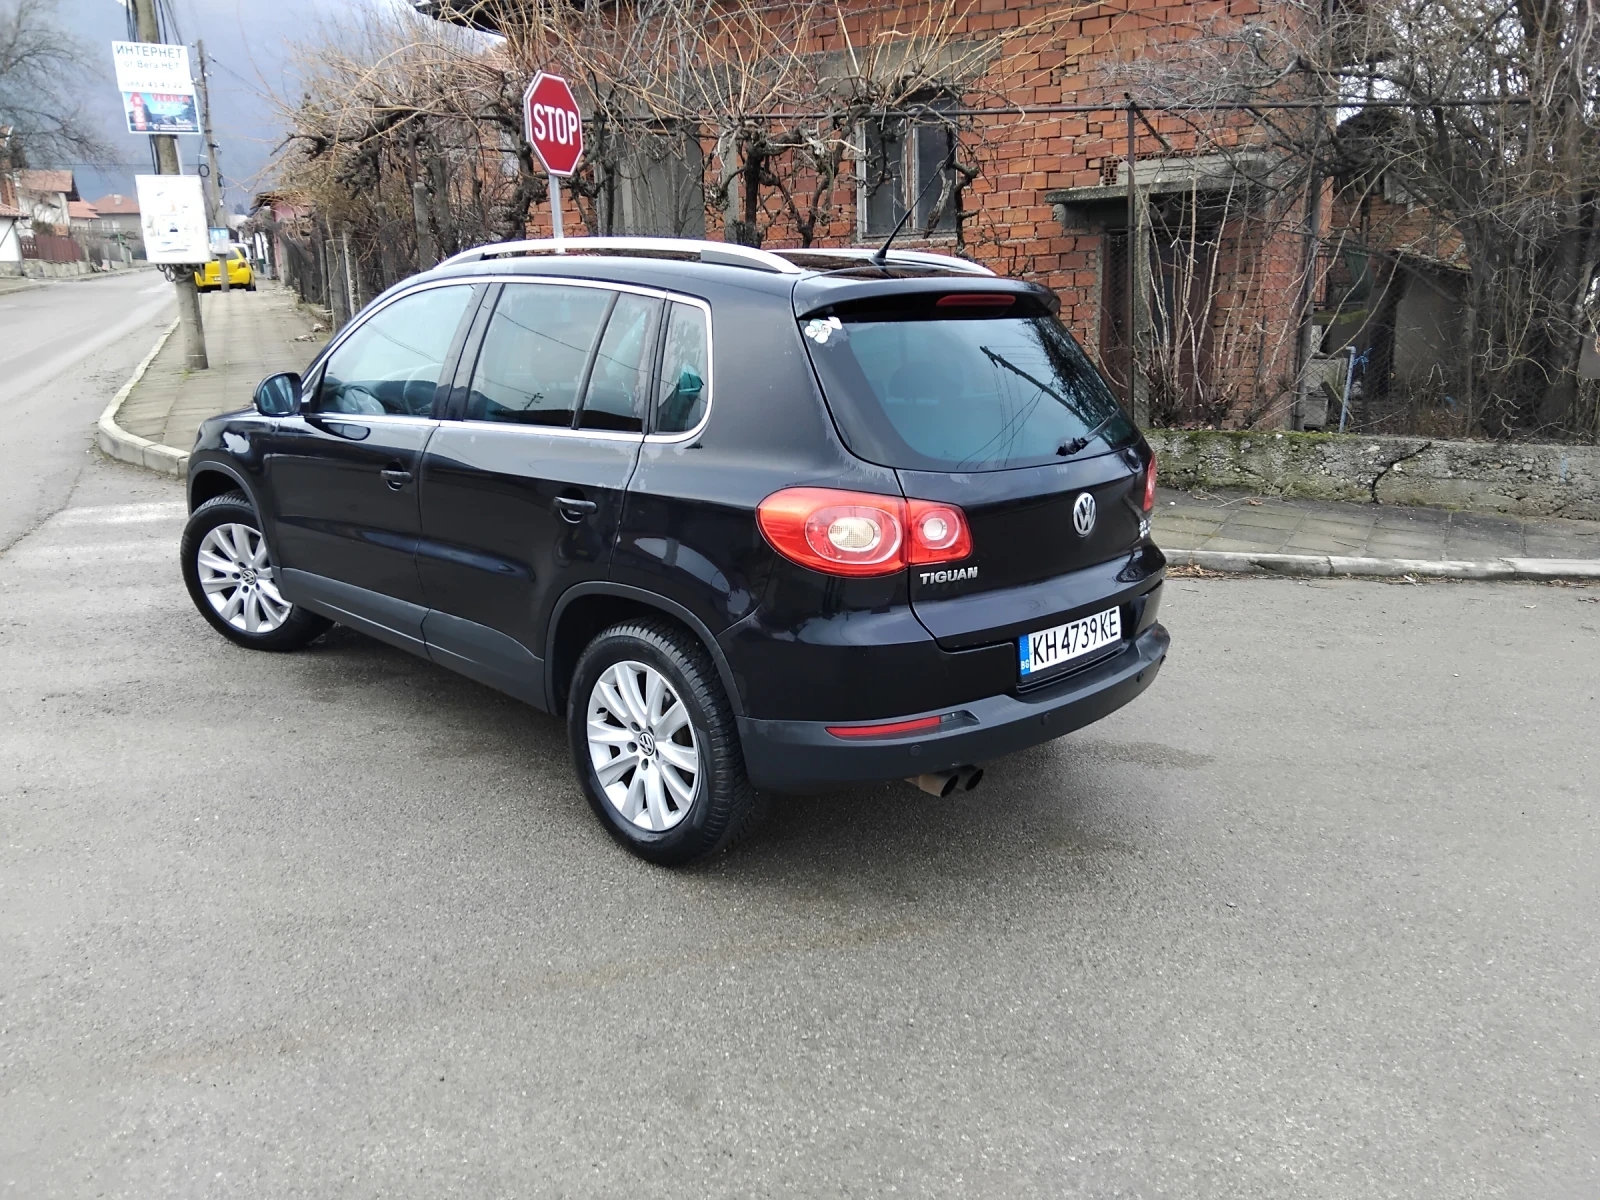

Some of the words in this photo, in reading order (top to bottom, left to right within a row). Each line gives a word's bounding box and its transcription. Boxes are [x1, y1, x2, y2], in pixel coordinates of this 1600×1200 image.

[116, 45, 182, 59] ИНТЕРНЕТ
[533, 103, 578, 146] STOP
[920, 566, 978, 585] TIGUAN
